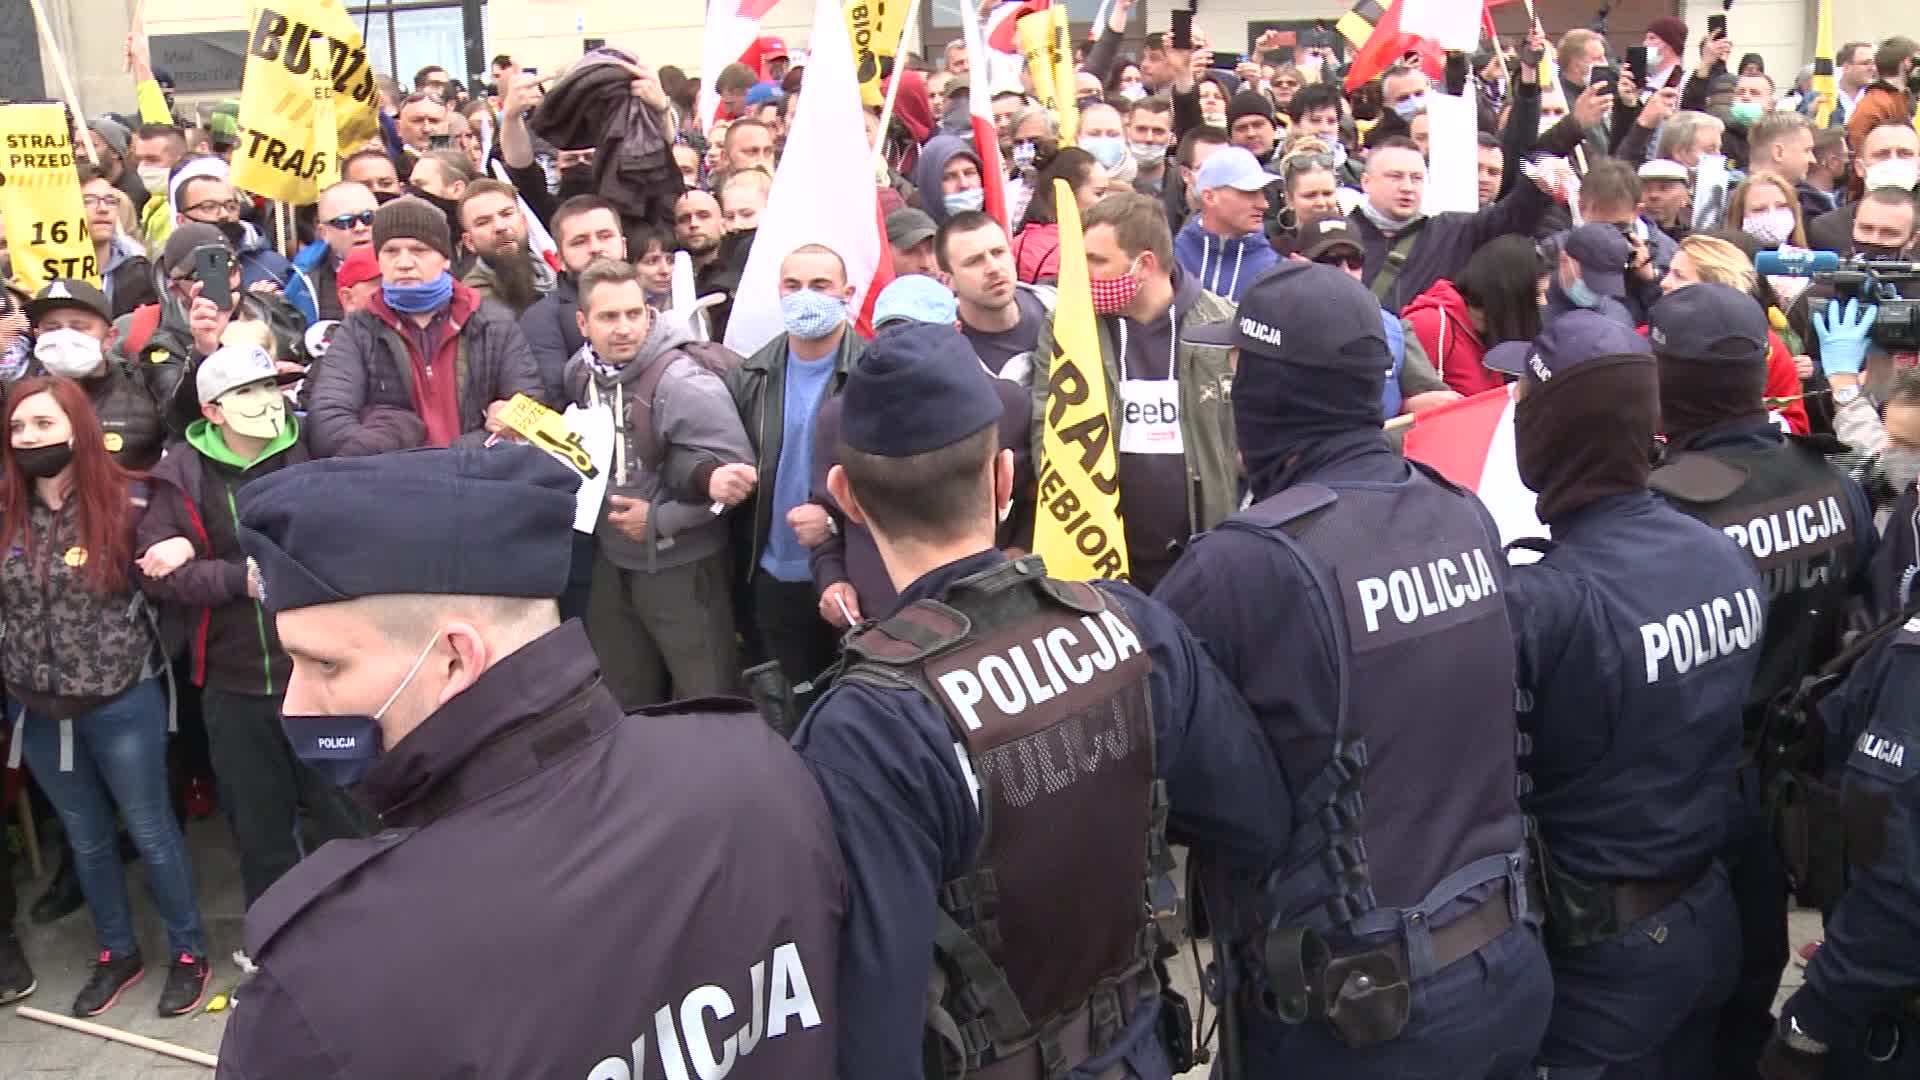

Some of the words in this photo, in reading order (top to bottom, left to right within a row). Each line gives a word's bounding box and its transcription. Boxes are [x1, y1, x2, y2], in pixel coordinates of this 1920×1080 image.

[7, 133, 71, 149] STRAJ
[10, 153, 75, 168] PRZED
[30, 220, 69, 245] 16
[1040, 457, 1129, 581] IĘBIOR
[1357, 548, 1498, 632] POLICJA
[938, 610, 1143, 731] POLICJA
[1640, 588, 1763, 683] POLICJA
[318, 737, 355, 749] POLICJA
[586, 942, 823, 1080] ICJA
